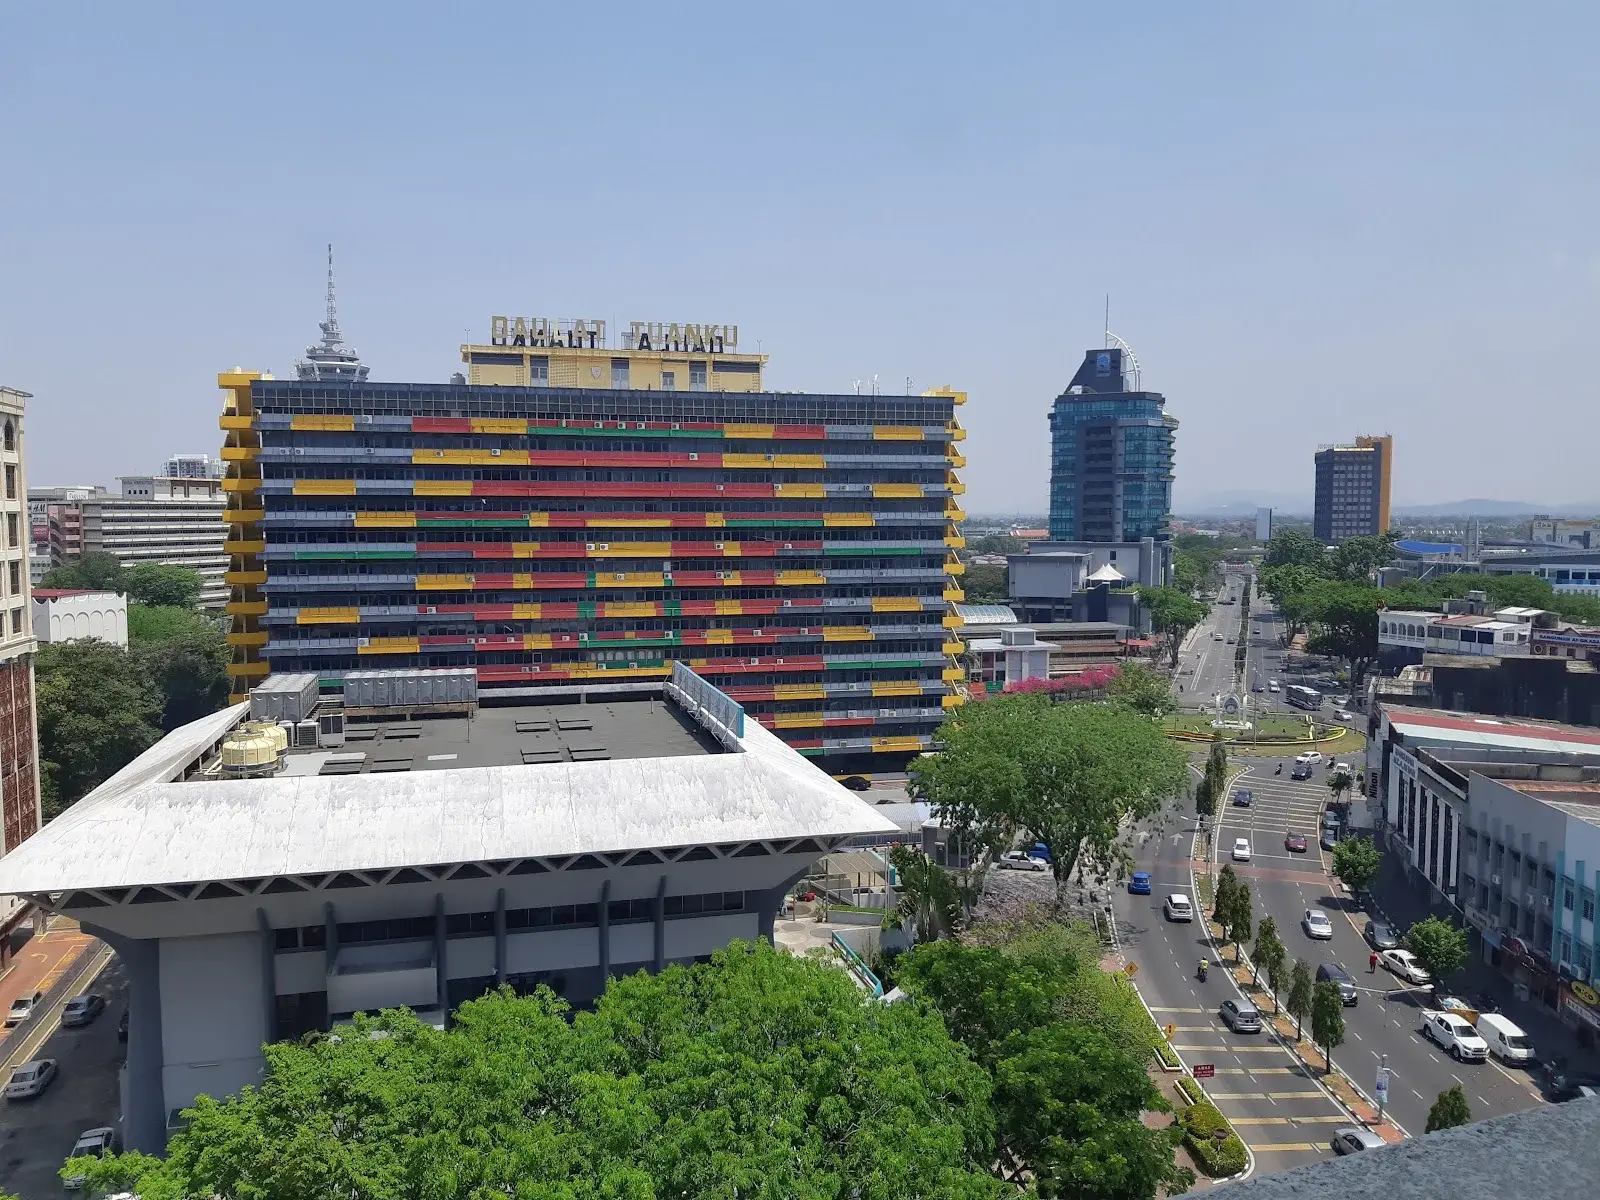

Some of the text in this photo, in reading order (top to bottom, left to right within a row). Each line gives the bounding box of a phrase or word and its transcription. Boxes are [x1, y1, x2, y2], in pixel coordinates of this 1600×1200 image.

[492, 316, 738, 346] DAULAT TUANKU
[1369, 772, 1378, 799] Nikon
